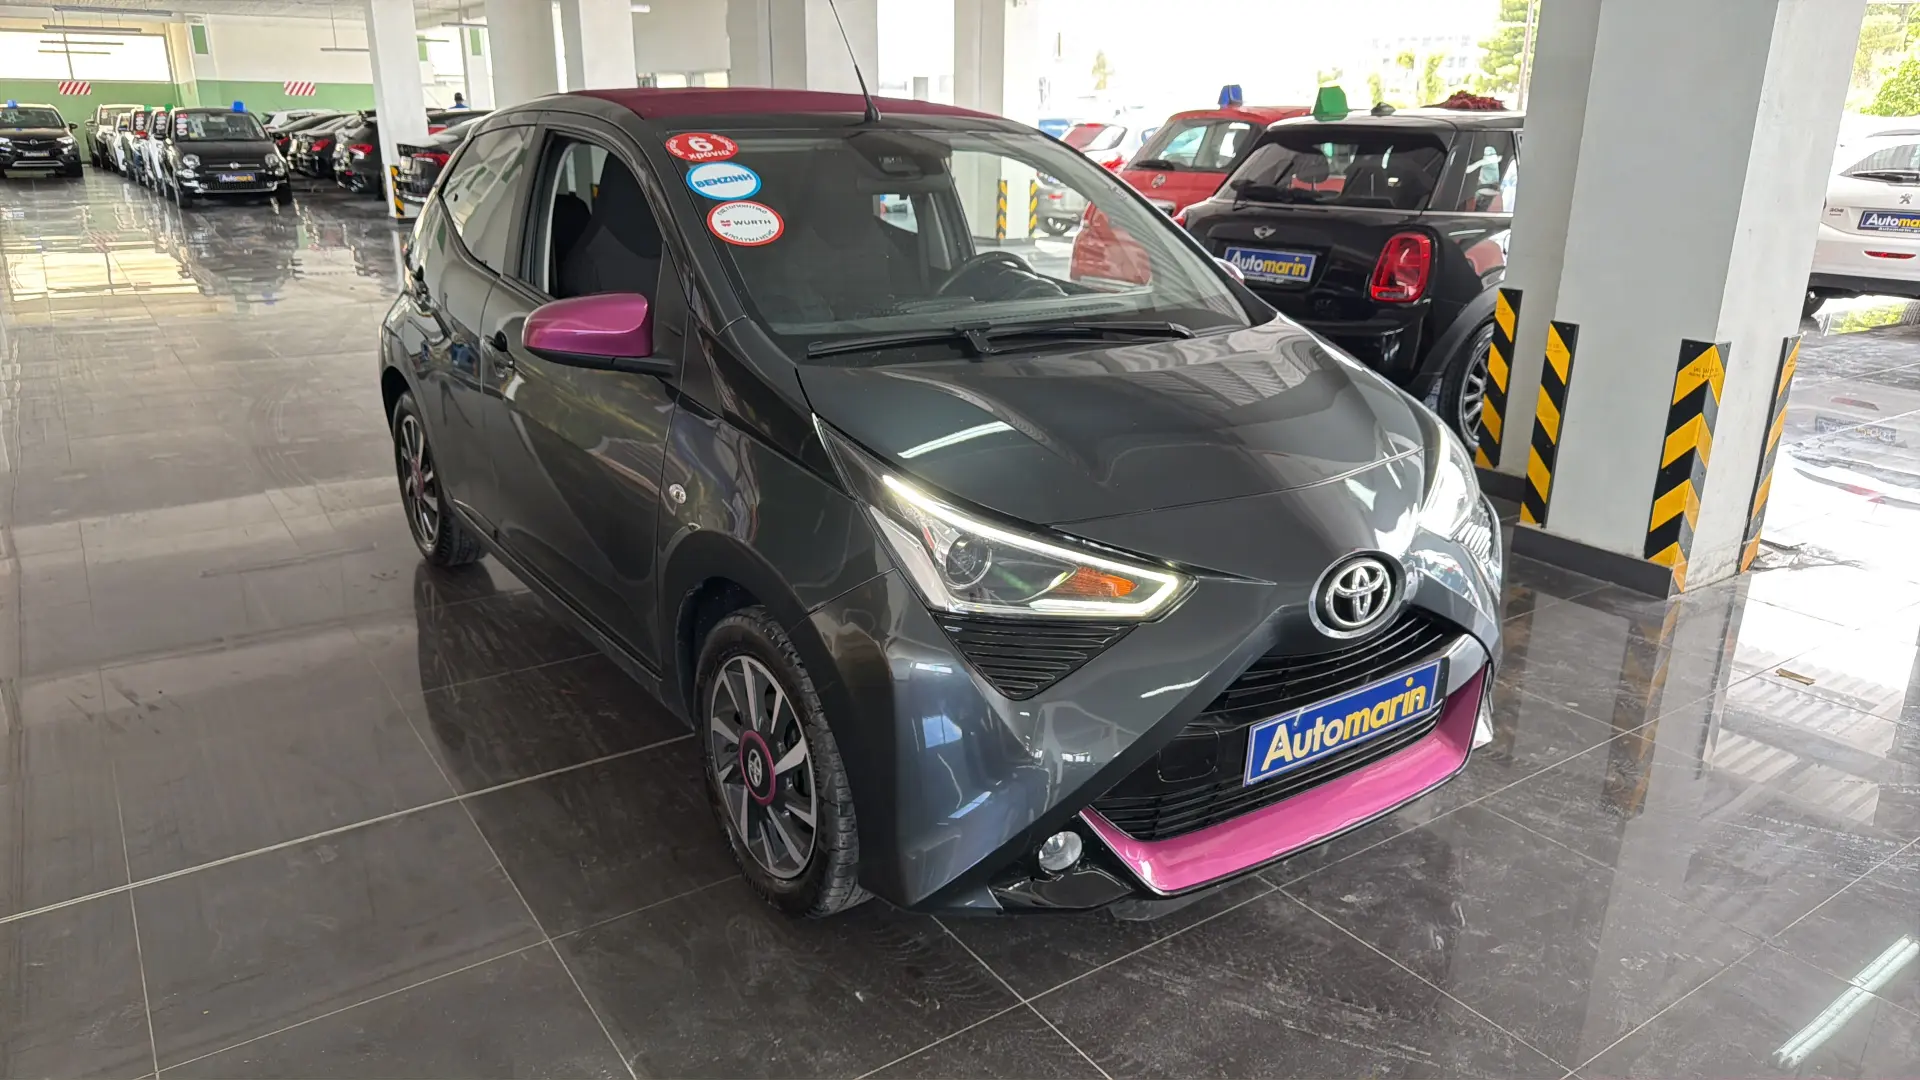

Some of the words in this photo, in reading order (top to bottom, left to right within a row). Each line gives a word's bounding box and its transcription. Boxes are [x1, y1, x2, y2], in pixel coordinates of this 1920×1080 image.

[688, 136, 713, 151] 6
[1231, 250, 1306, 276] Automarin
[1261, 677, 1426, 771] Automarin
